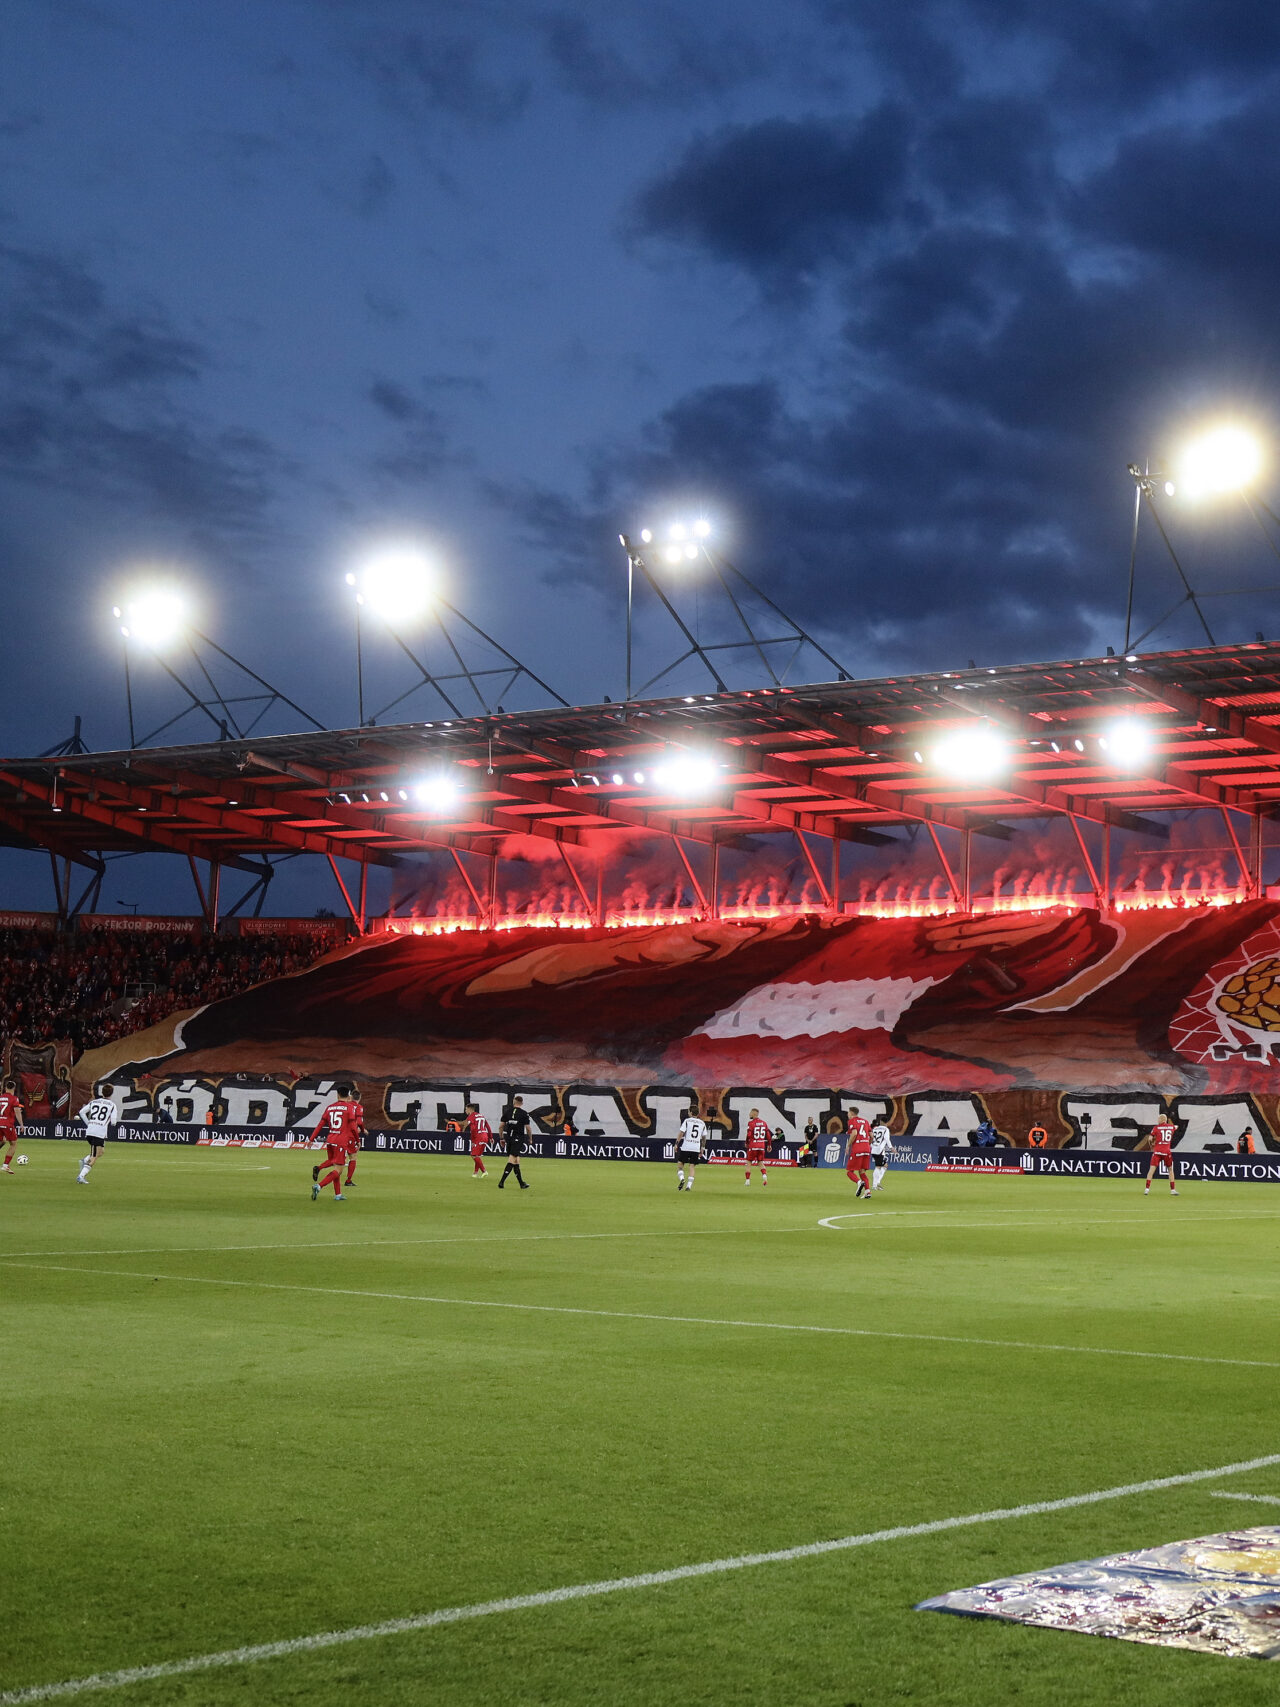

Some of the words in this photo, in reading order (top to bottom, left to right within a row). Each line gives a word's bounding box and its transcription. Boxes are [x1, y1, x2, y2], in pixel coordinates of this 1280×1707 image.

[104, 920, 142, 930] SEKTOR
[91, 1105, 108, 1121] 28
[329, 1111, 343, 1129] 15
[15, 1126, 46, 1136] TTONI
[129, 1128, 190, 1142] PANATTONI
[211, 1131, 275, 1142] PANATTONI
[690, 1124, 699, 1139] 5
[753, 1126, 766, 1139] 55
[858, 1124, 867, 1138] 4
[1160, 1129, 1172, 1142] 16
[389, 1136, 442, 1151] PATTONI
[469, 1138, 543, 1155] NATONI
[570, 1142, 650, 1158] PANATTONI
[883, 1153, 933, 1164] STRAKLASA
[1039, 1157, 1142, 1175] PANATTONI
